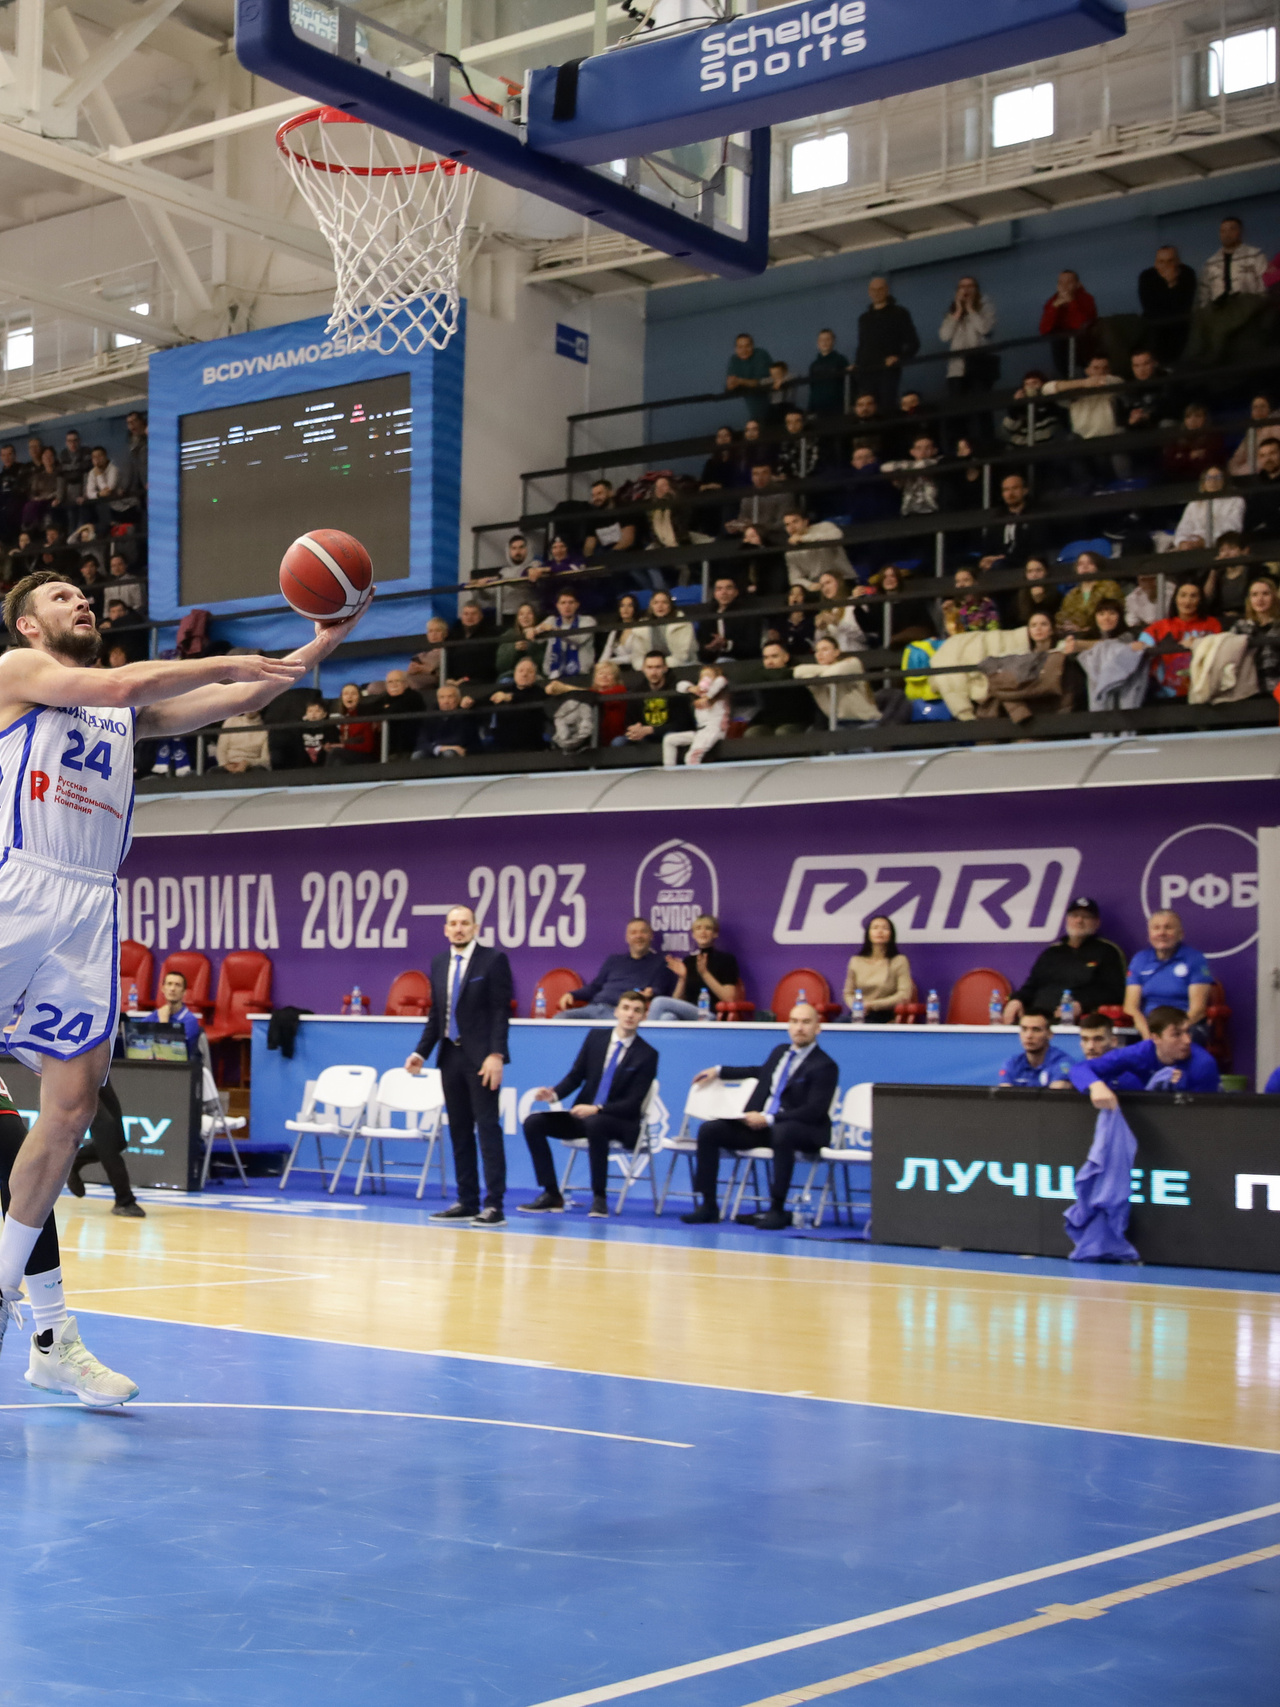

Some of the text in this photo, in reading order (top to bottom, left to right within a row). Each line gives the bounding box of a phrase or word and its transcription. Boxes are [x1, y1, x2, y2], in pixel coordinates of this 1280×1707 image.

[701, 1, 866, 63] Schelde
[700, 29, 867, 92] Sports
[61, 729, 112, 780] 24
[54, 795, 92, 815] Компания
[58, 775, 88, 793] Русская
[787, 861, 1063, 931] PARI
[1161, 873, 1259, 909] РФБ
[29, 1003, 94, 1045] 24
